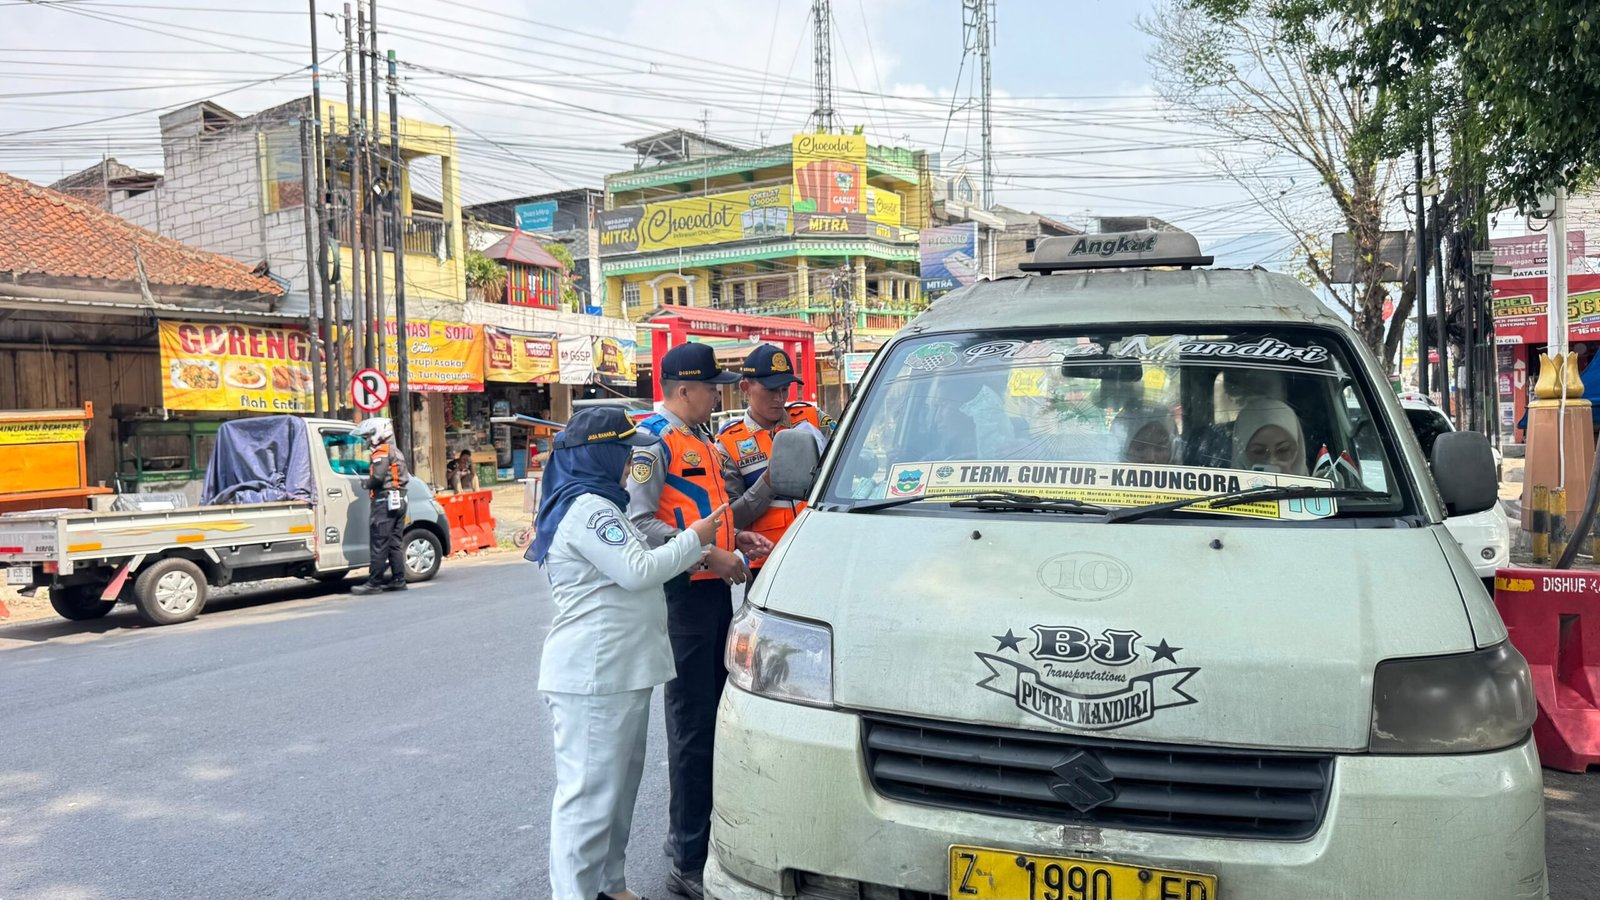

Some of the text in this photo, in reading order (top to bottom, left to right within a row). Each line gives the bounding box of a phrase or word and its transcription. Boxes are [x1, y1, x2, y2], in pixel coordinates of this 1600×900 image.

[798, 137, 855, 155] Chocodot
[648, 203, 735, 243] Chocodot
[809, 218, 849, 231] MITRA
[601, 229, 637, 246] MITRA
[926, 279, 953, 289] MITRA
[1493, 297, 1529, 307] CHER
[1494, 305, 1548, 317] TERNET
[445, 325, 473, 340] SOTO
[1107, 334, 1330, 362] Mandiri
[740, 454, 766, 466] ARIPIN
[960, 465, 1013, 483] TERM.
[1017, 466, 1097, 486] GUNTUR
[1111, 468, 1241, 493] KADUNGORA
[1050, 559, 1123, 591] 10
[1542, 577, 1587, 593] DISHUB
[1029, 624, 1142, 666] BJ
[1043, 663, 1127, 682] Transportations
[1021, 679, 1149, 725] PUTRA MANDIRI
[959, 853, 978, 894] Z
[1025, 861, 1112, 900] 1990
